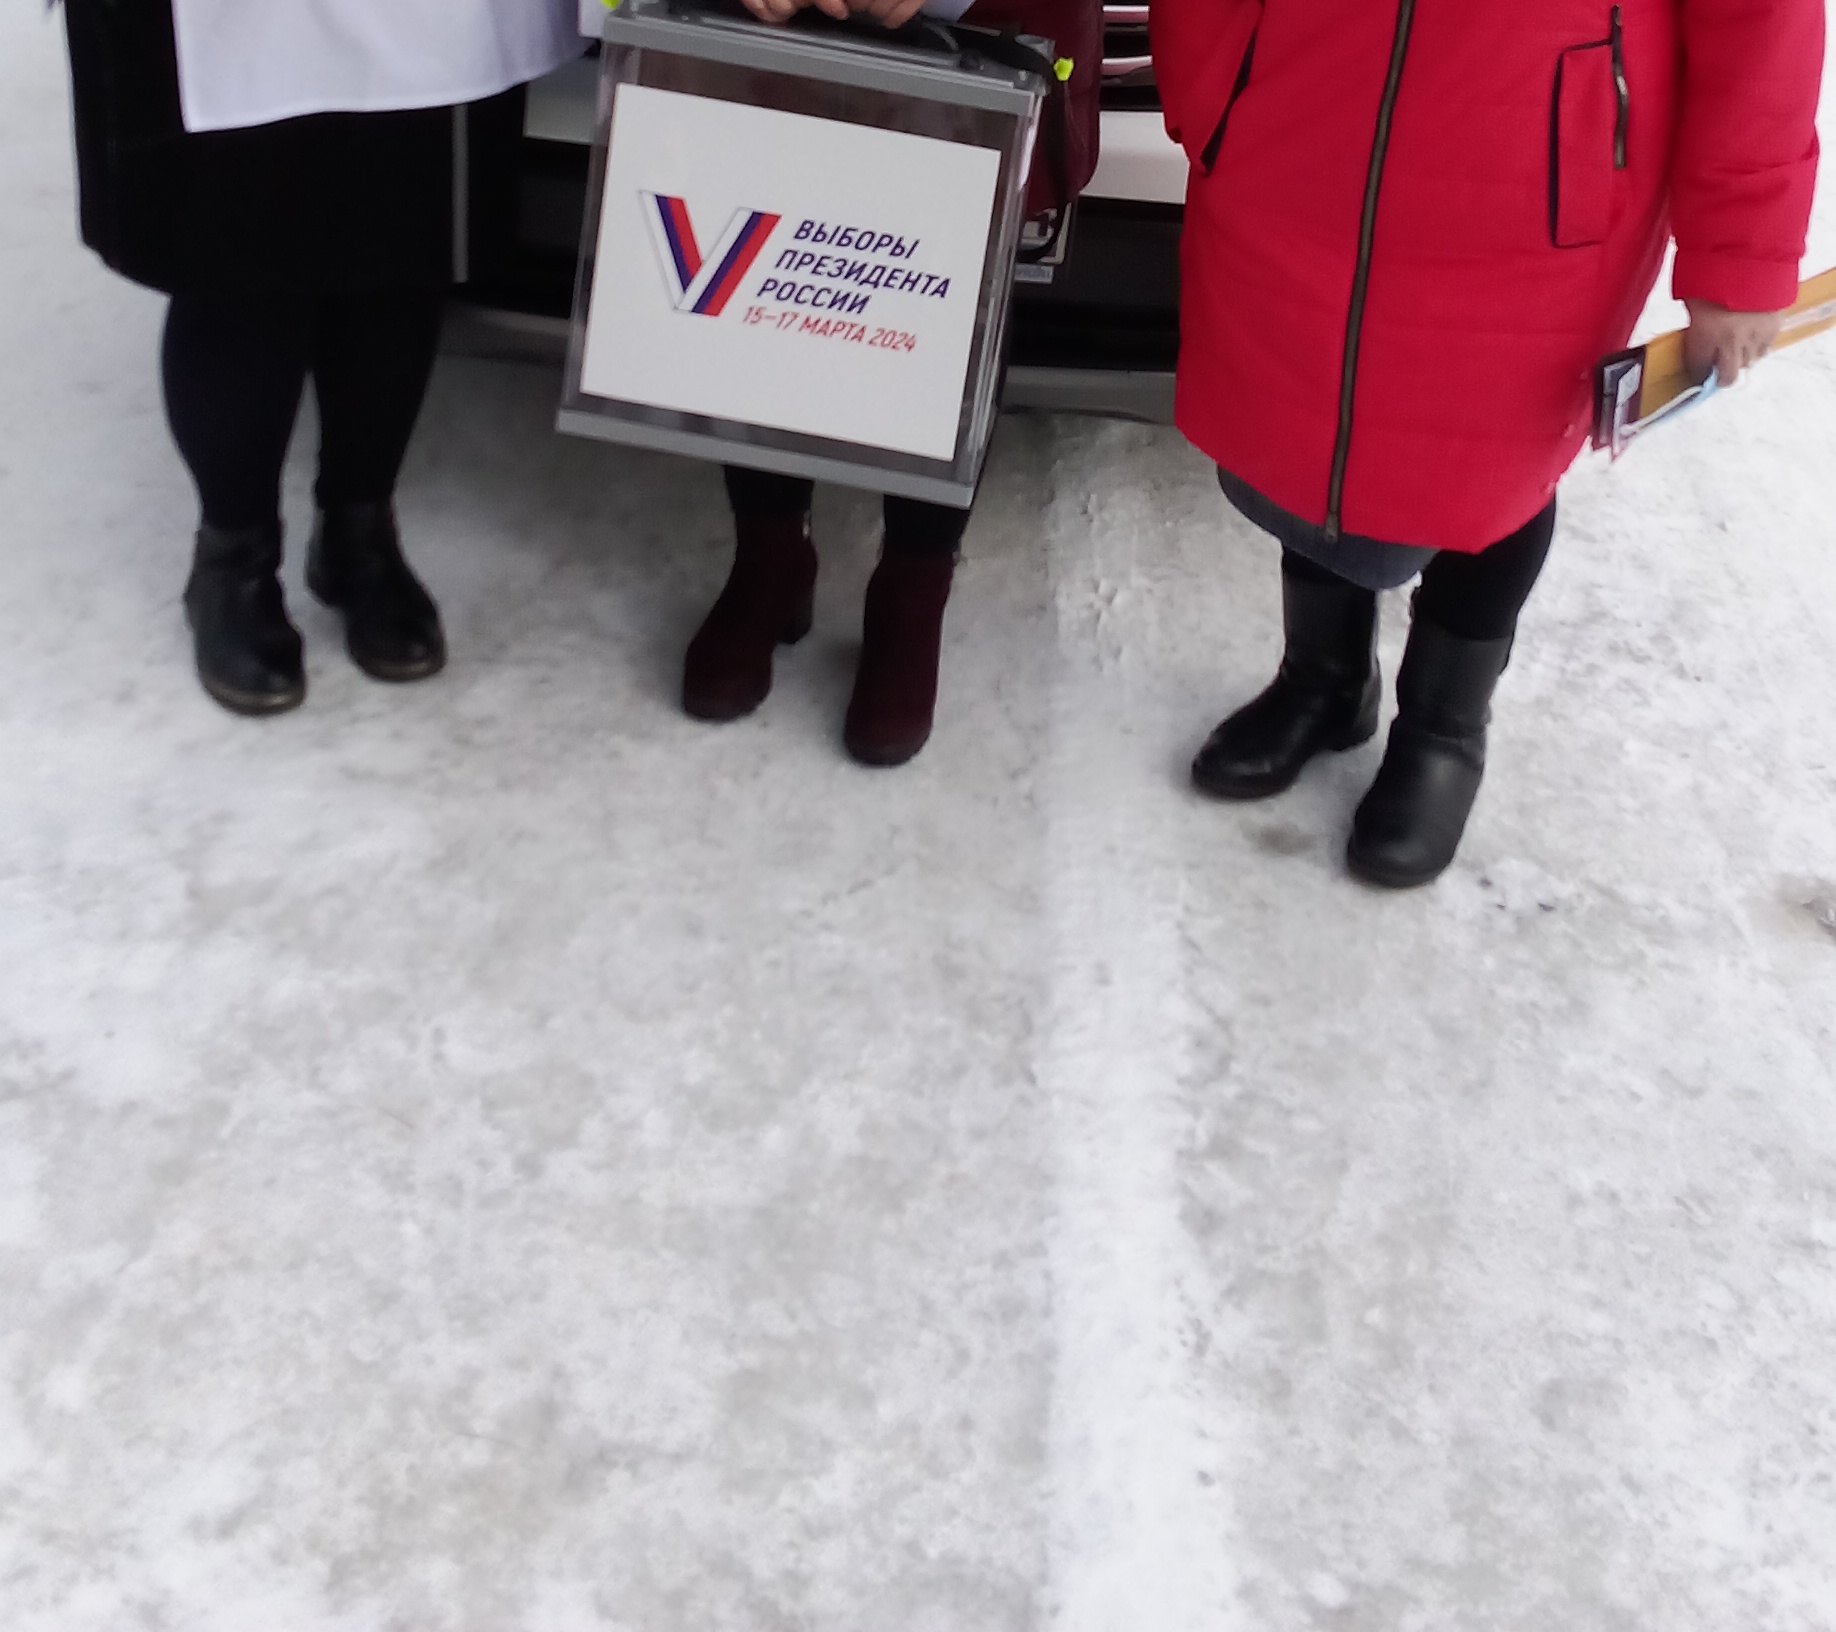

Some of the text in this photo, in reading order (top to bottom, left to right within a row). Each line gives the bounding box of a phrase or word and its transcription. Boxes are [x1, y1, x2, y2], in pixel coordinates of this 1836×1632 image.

[794, 220, 920, 259] ВЫБОРЫ
[775, 249, 952, 298] ПРЕЗИДЕНТА
[757, 279, 871, 315] РОССИИ
[799, 318, 867, 343] МАРТА
[868, 328, 917, 352] 2024
